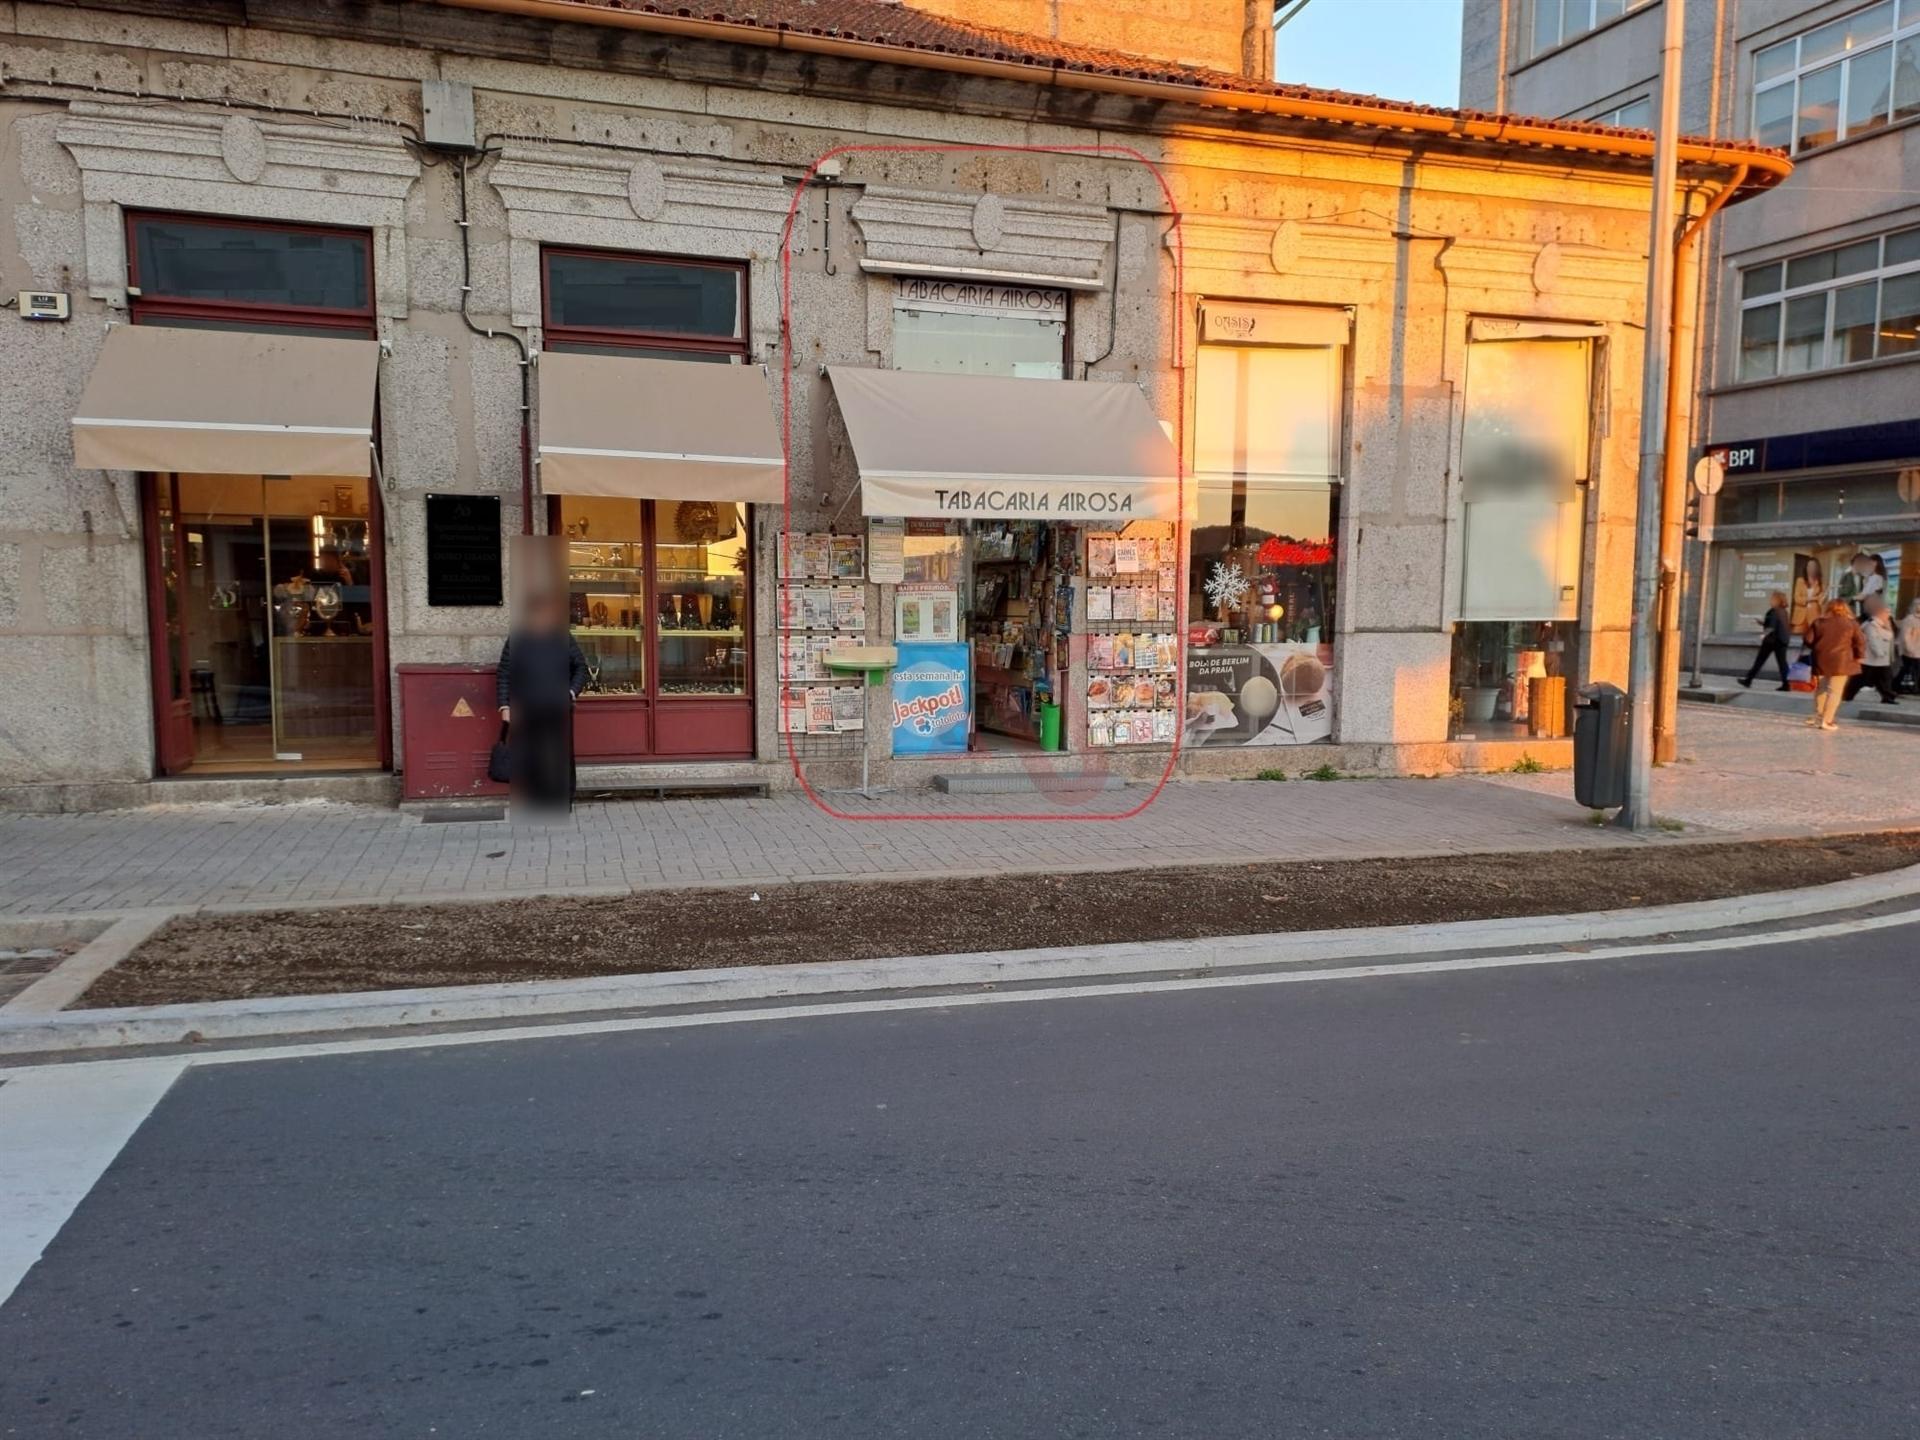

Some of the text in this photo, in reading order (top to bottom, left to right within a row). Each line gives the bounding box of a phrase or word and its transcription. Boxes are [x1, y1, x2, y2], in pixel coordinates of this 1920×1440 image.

[896, 279, 1064, 310] TABACARIA AIROSA
[1729, 448, 1754, 467] BPI
[387, 476, 396, 491] 6
[935, 490, 1132, 512] TABACARIA AIROSA
[1189, 657, 1250, 668] BOLA DE BERLIM
[1199, 666, 1233, 675] DA PRAIA
[894, 670, 965, 681] esta semana há
[893, 684, 963, 727] Jackpot!
